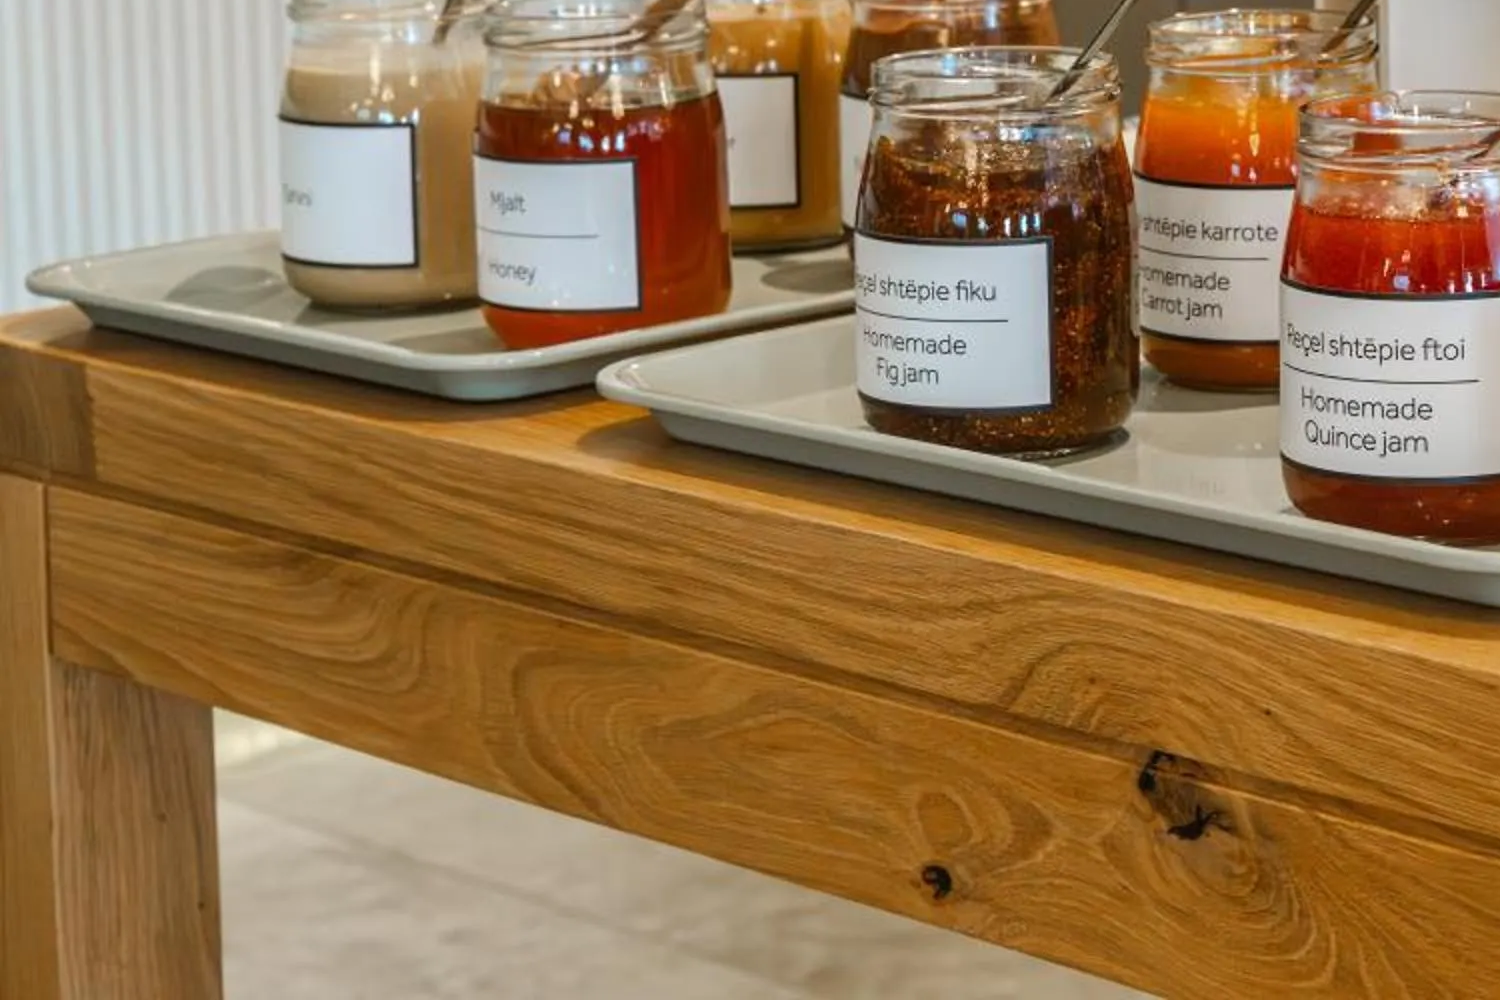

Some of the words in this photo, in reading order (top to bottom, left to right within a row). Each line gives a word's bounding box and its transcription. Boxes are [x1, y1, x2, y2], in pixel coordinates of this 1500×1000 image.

[1201, 220, 1279, 243] karrote
[879, 274, 951, 305] shtëpie
[954, 279, 998, 302] fiku
[1184, 296, 1224, 321] jam
[862, 325, 968, 356] Homemade
[1287, 322, 1326, 358] Reçel
[1328, 333, 1416, 369] shtëpie
[1421, 336, 1467, 362] ftoi
[875, 355, 899, 387] Fig
[901, 362, 940, 388] jam
[1300, 384, 1434, 421] Homemade
[1304, 418, 1377, 452] Quince
[1379, 430, 1430, 459] jam
